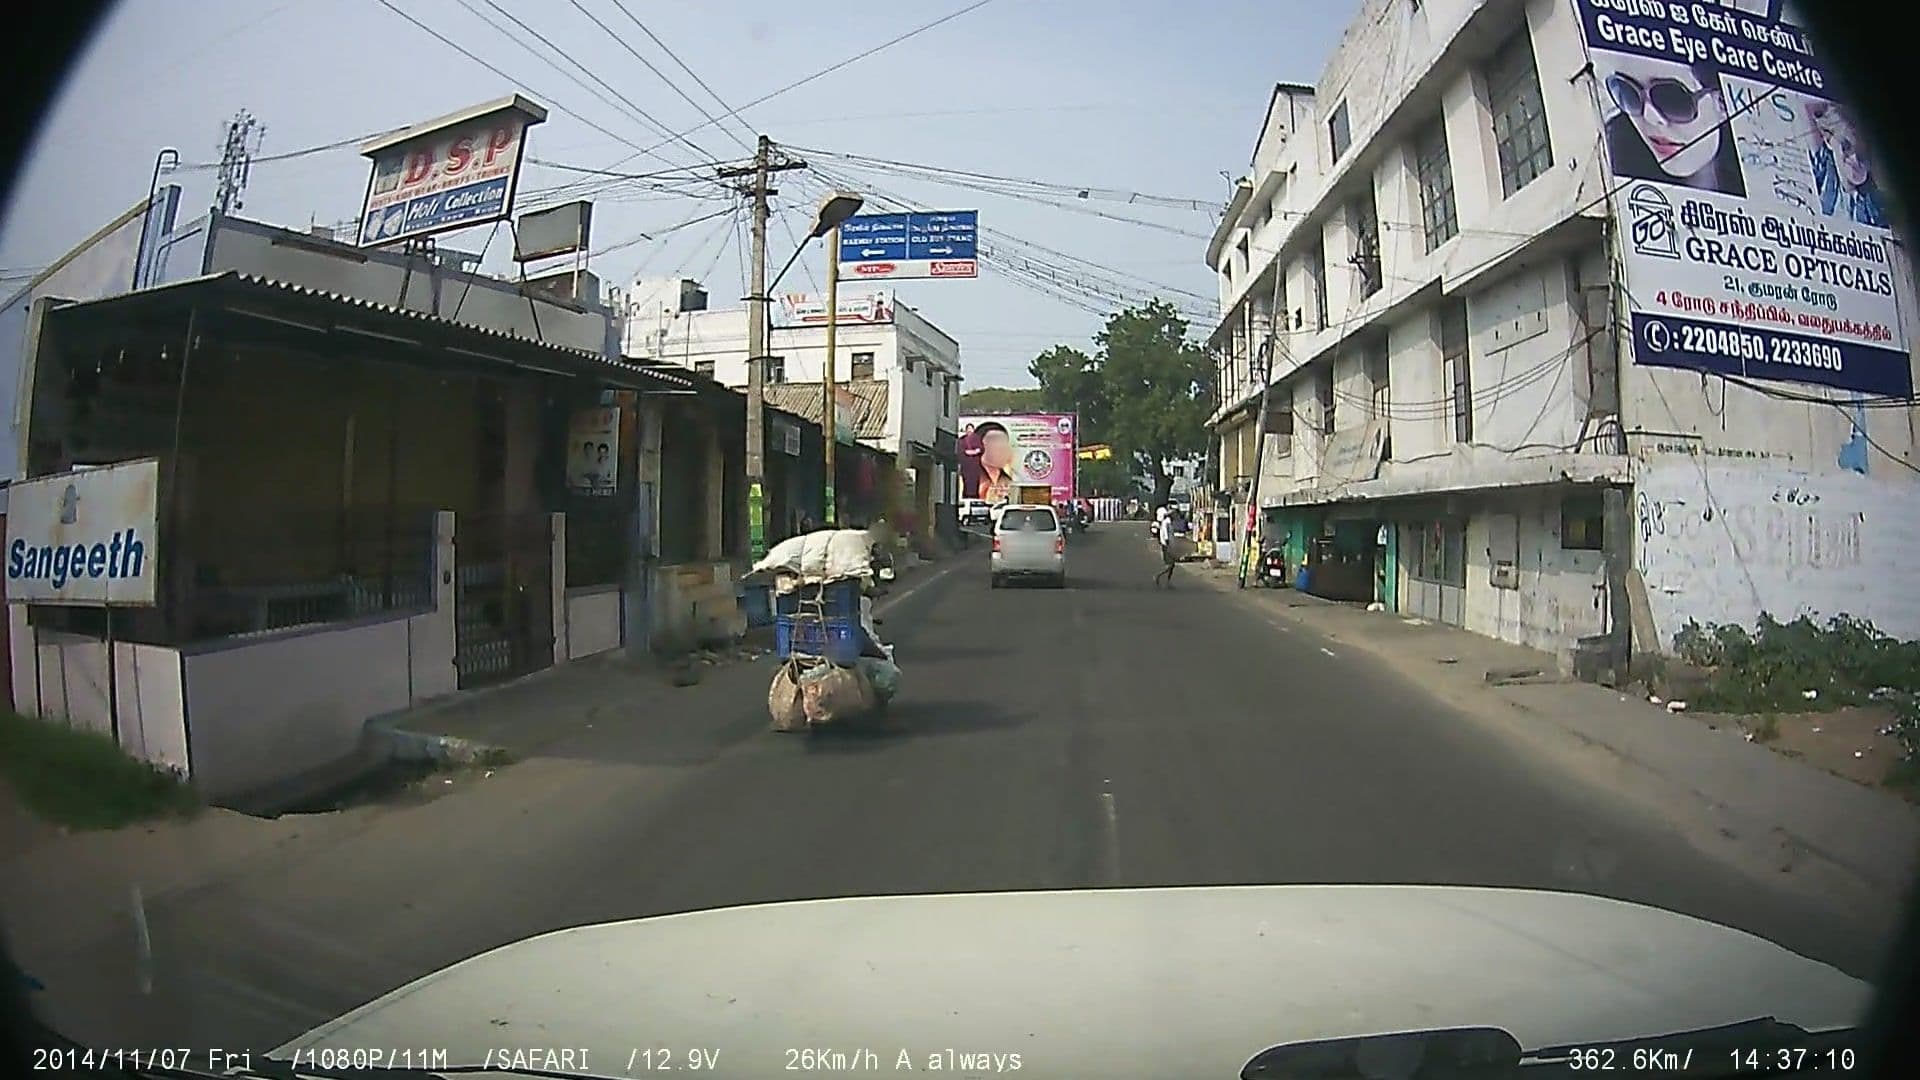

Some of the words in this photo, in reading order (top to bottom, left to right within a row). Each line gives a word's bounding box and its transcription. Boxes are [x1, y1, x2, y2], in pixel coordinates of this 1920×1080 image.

[1597, 14, 1666, 51] Grace
[1668, 27, 1708, 63] Eye
[1711, 37, 1760, 71] Care
[1762, 49, 1824, 89] Centre
[1680, 200, 1757, 237] கிரேஸ்
[1685, 236, 1778, 274] GRACE
[1784, 253, 1893, 297] OPTICALS
[1655, 290, 1668, 307] 4
[1671, 291, 1716, 315] ரோடு
[1801, 285, 1838, 311] ரோடு
[8, 528, 145, 589] Sangeeth
